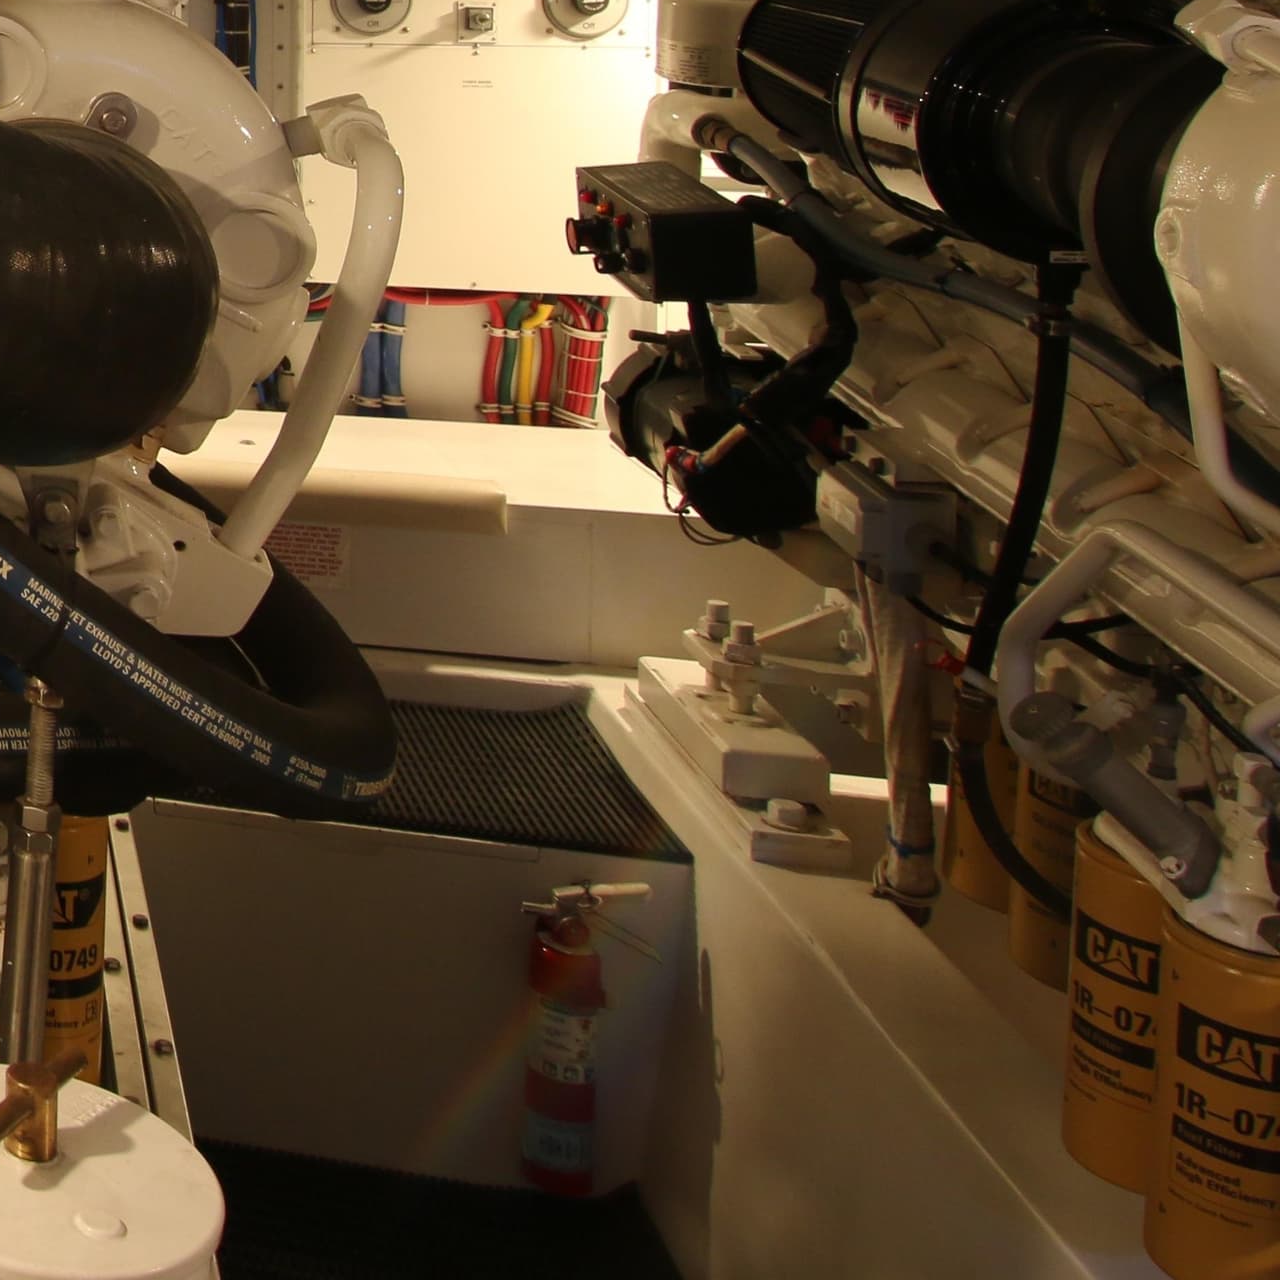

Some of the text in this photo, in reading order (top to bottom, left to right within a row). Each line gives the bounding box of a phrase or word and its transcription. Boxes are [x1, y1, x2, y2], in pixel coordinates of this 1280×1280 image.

[582, 22, 596, 30] Off
[20, 588, 43, 609] SAE
[92, 643, 132, 676] LLOYD'S
[130, 672, 181, 711] APPROVED
[180, 705, 205, 727] CERT
[206, 721, 245, 750] 03/60002
[27, 578, 65, 611] MARINE
[85, 622, 128, 658] EXHAUST
[127, 652, 135, 665] &
[137, 659, 169, 688] WATER
[169, 682, 193, 705] HOSE
[1087, 927, 1156, 984] CAT
[1073, 980, 1157, 1038] 1R-07
[1196, 1024, 1280, 1084] CAT
[1174, 1081, 1280, 1140] 1R-07
